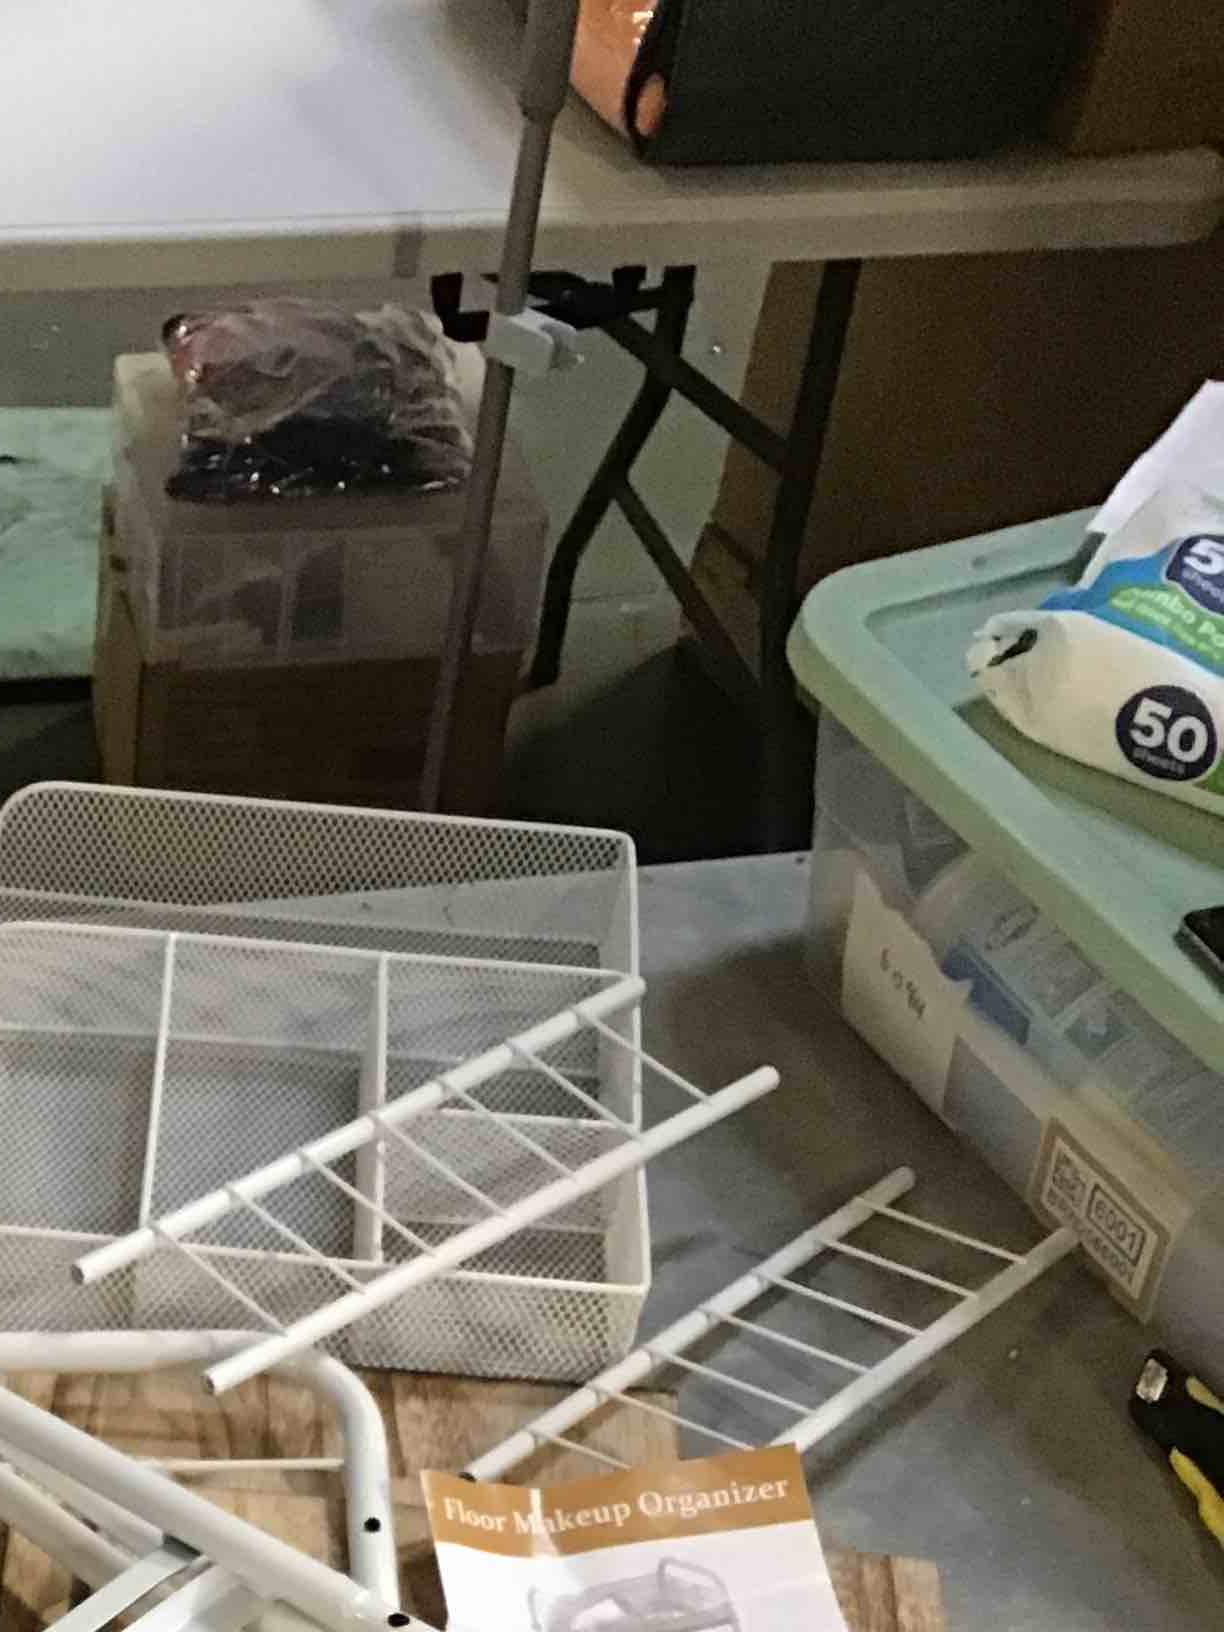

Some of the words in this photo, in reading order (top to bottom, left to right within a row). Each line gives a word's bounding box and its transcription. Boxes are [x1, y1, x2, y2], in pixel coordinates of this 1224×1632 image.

[1130, 697, 1209, 763] 50
[443, 1496, 507, 1534] Floor
[637, 1478, 790, 1519] Organizer
